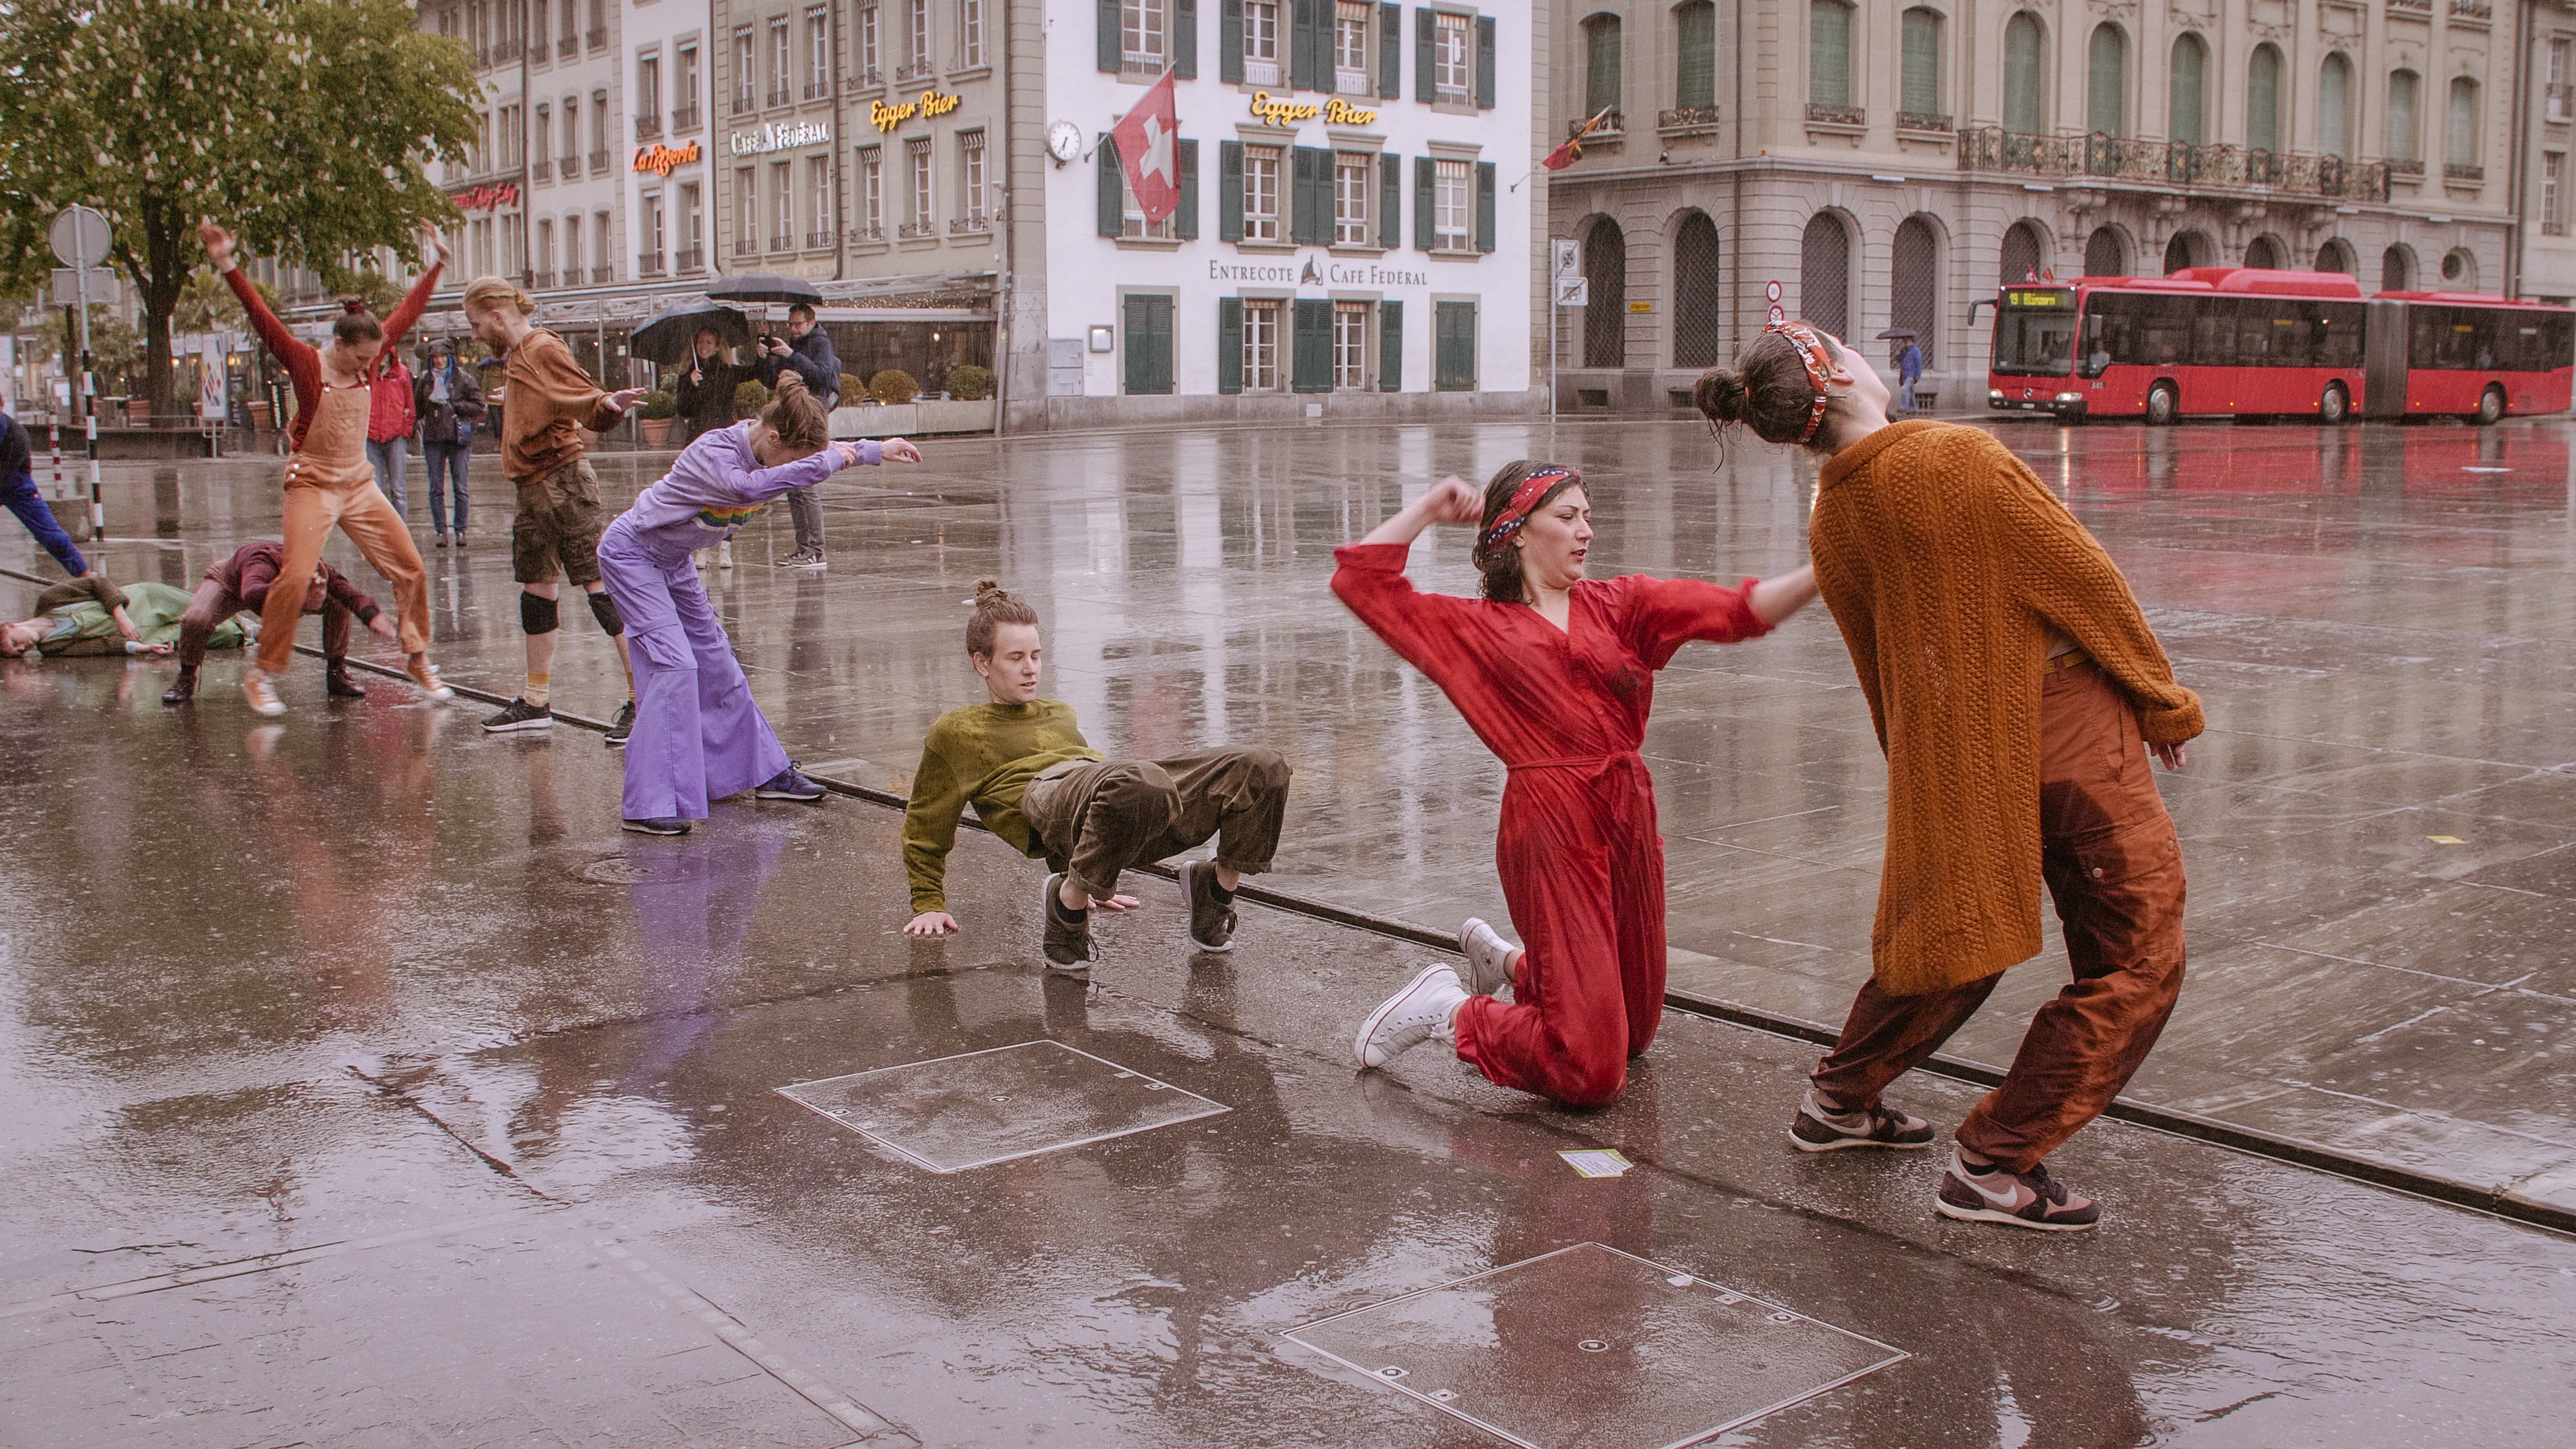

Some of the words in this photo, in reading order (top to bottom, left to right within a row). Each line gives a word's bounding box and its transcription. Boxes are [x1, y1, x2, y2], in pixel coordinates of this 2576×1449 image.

[870, 99, 915, 133] Egger
[920, 90, 959, 118] Bier
[1251, 90, 1319, 126] Egger
[1325, 98, 1377, 124] Bier
[1210, 260, 1294, 282] ENTRECOTE
[1330, 264, 1364, 283] CAFÉ
